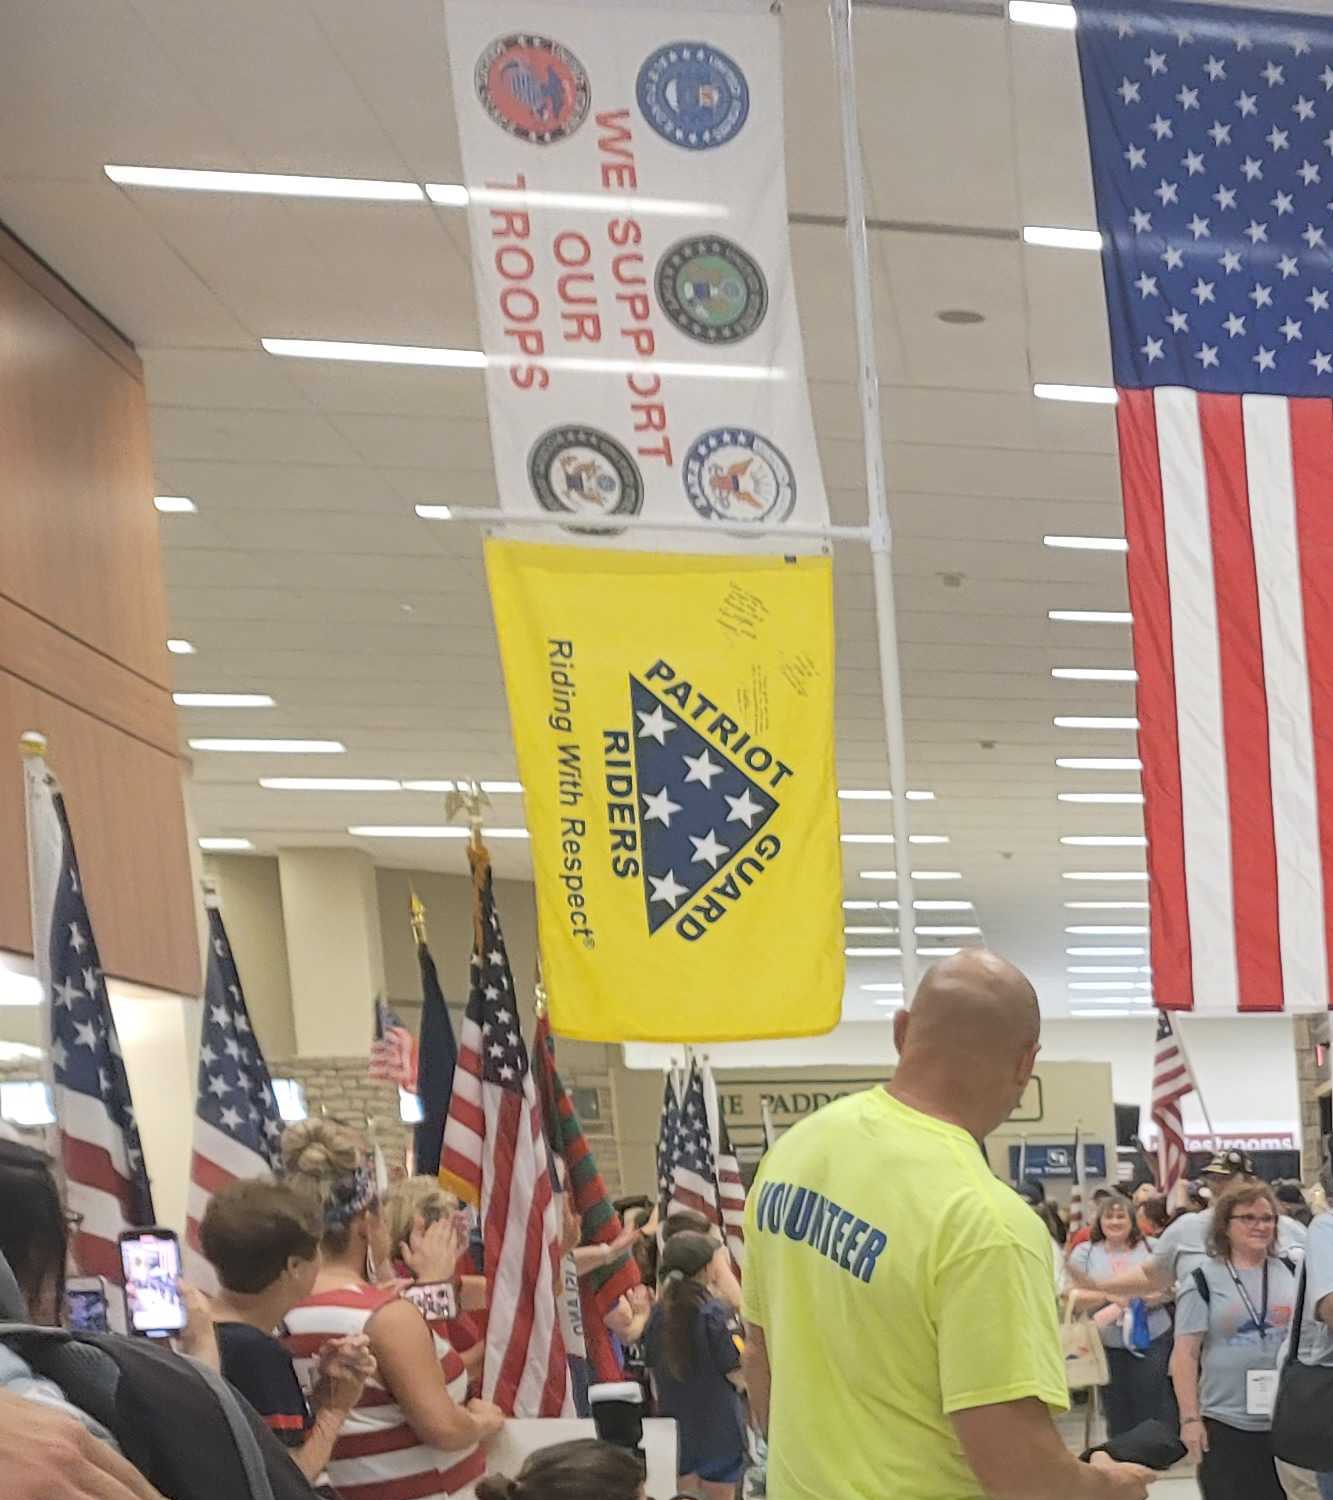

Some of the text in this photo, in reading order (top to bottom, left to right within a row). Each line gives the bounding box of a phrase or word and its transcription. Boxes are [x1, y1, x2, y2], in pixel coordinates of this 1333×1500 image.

[553, 231, 602, 344] OUR
[594, 108, 673, 467] WE SUPPORT
[547, 638, 574, 734] Riding
[644, 658, 794, 790] PATRIOT
[557, 743, 583, 804] With
[602, 729, 640, 881] RIDERS
[675, 833, 782, 943] GUARD
[1184, 1134, 1293, 1152] estrooms
